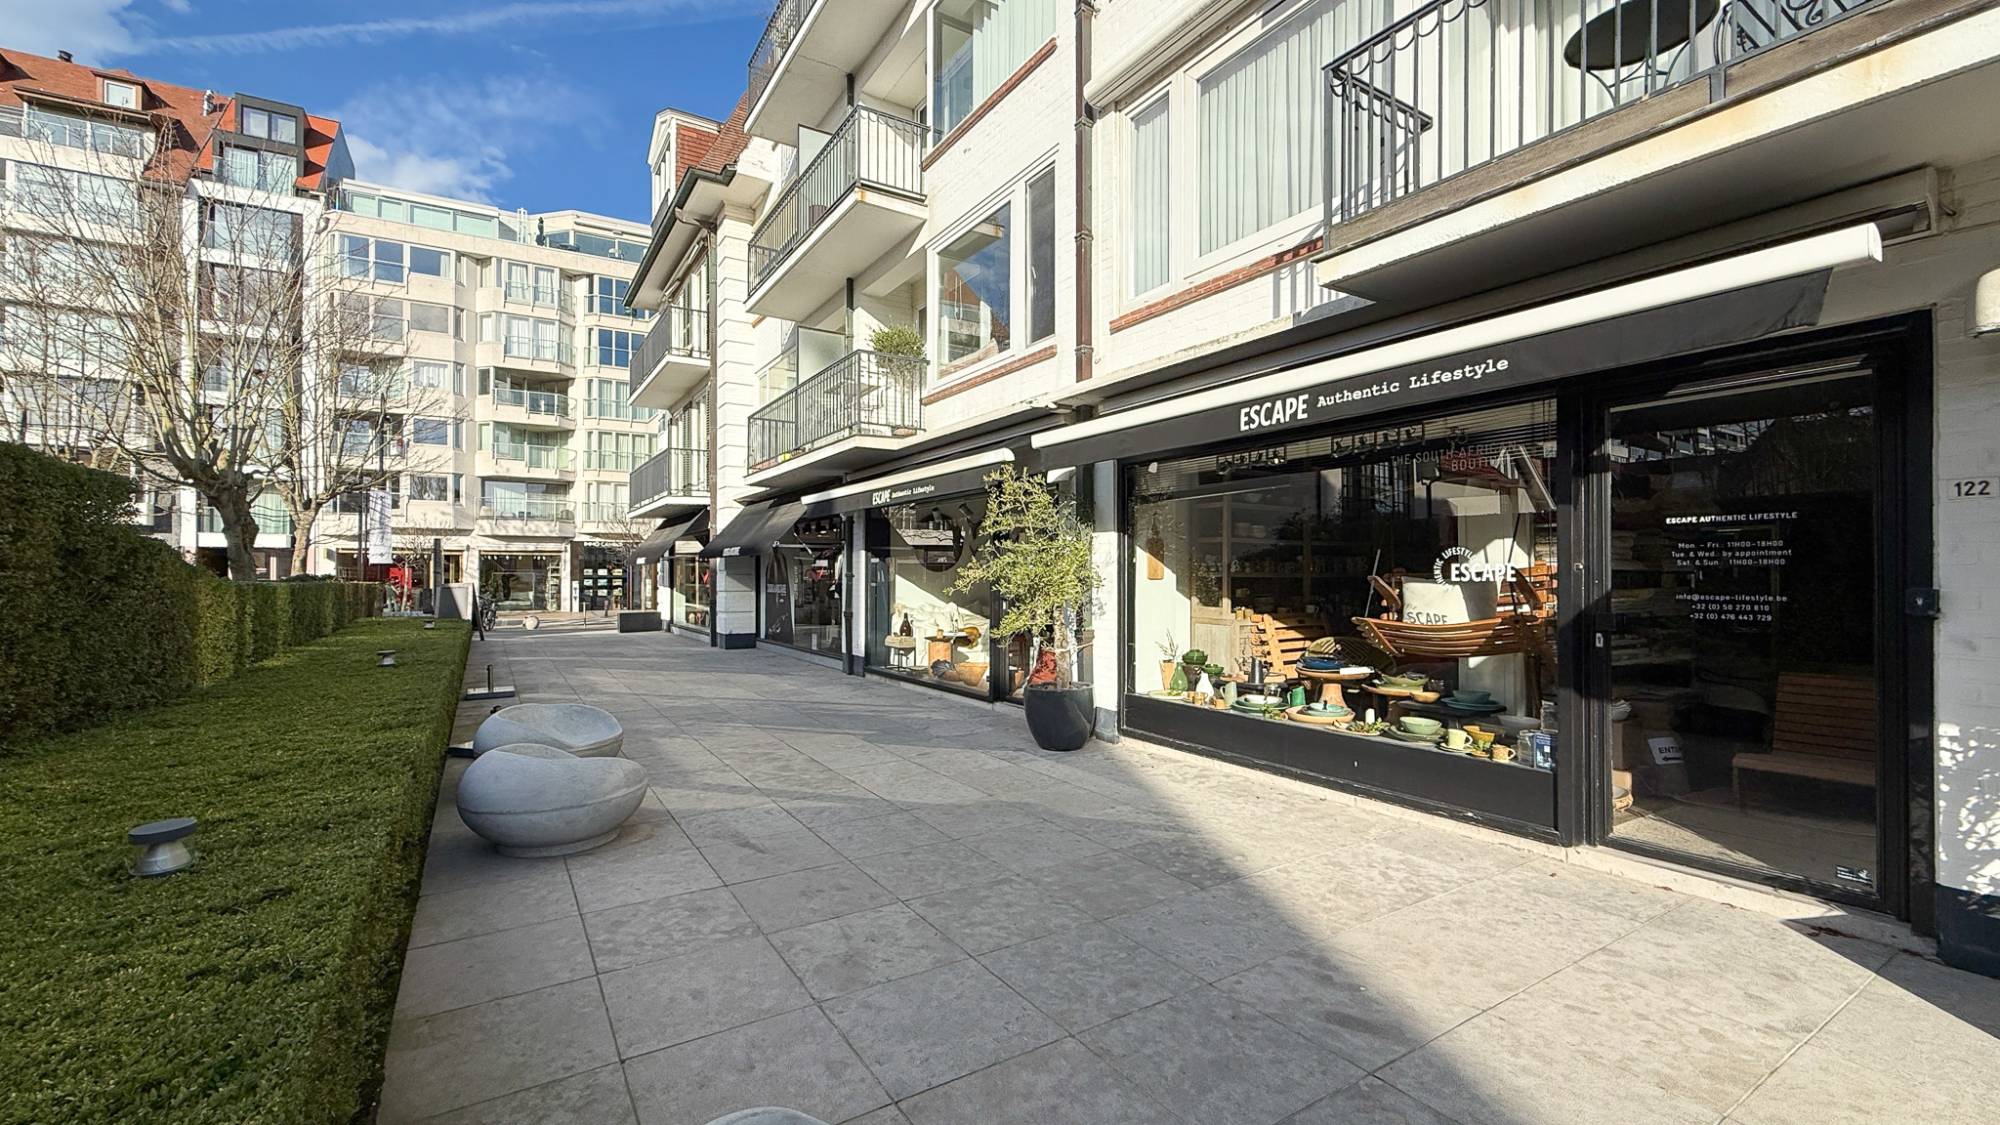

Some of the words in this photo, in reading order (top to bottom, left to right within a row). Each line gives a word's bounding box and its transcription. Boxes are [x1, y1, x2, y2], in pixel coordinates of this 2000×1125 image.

[1239, 393, 1309, 431] ESCAPE
[1317, 381, 1400, 408] Authentic
[1408, 358, 1509, 389] Lifestyle
[1415, 448, 1455, 464] SOUTH
[1953, 480, 1990, 497] 122
[872, 489, 891, 506] ESCAPE
[1665, 516, 1698, 524] ESCAPE
[1699, 514, 1747, 523] AUTHENTIC
[1749, 511, 1798, 520] LIFESTYLE
[1442, 547, 1477, 560] LIFESTYL
[1734, 549, 1793, 558] appointment
[1450, 563, 1517, 582] ESCAPE
[1675, 594, 1788, 602] info@escape-lifestylebe
[1706, 612, 1718, 620] (0)
